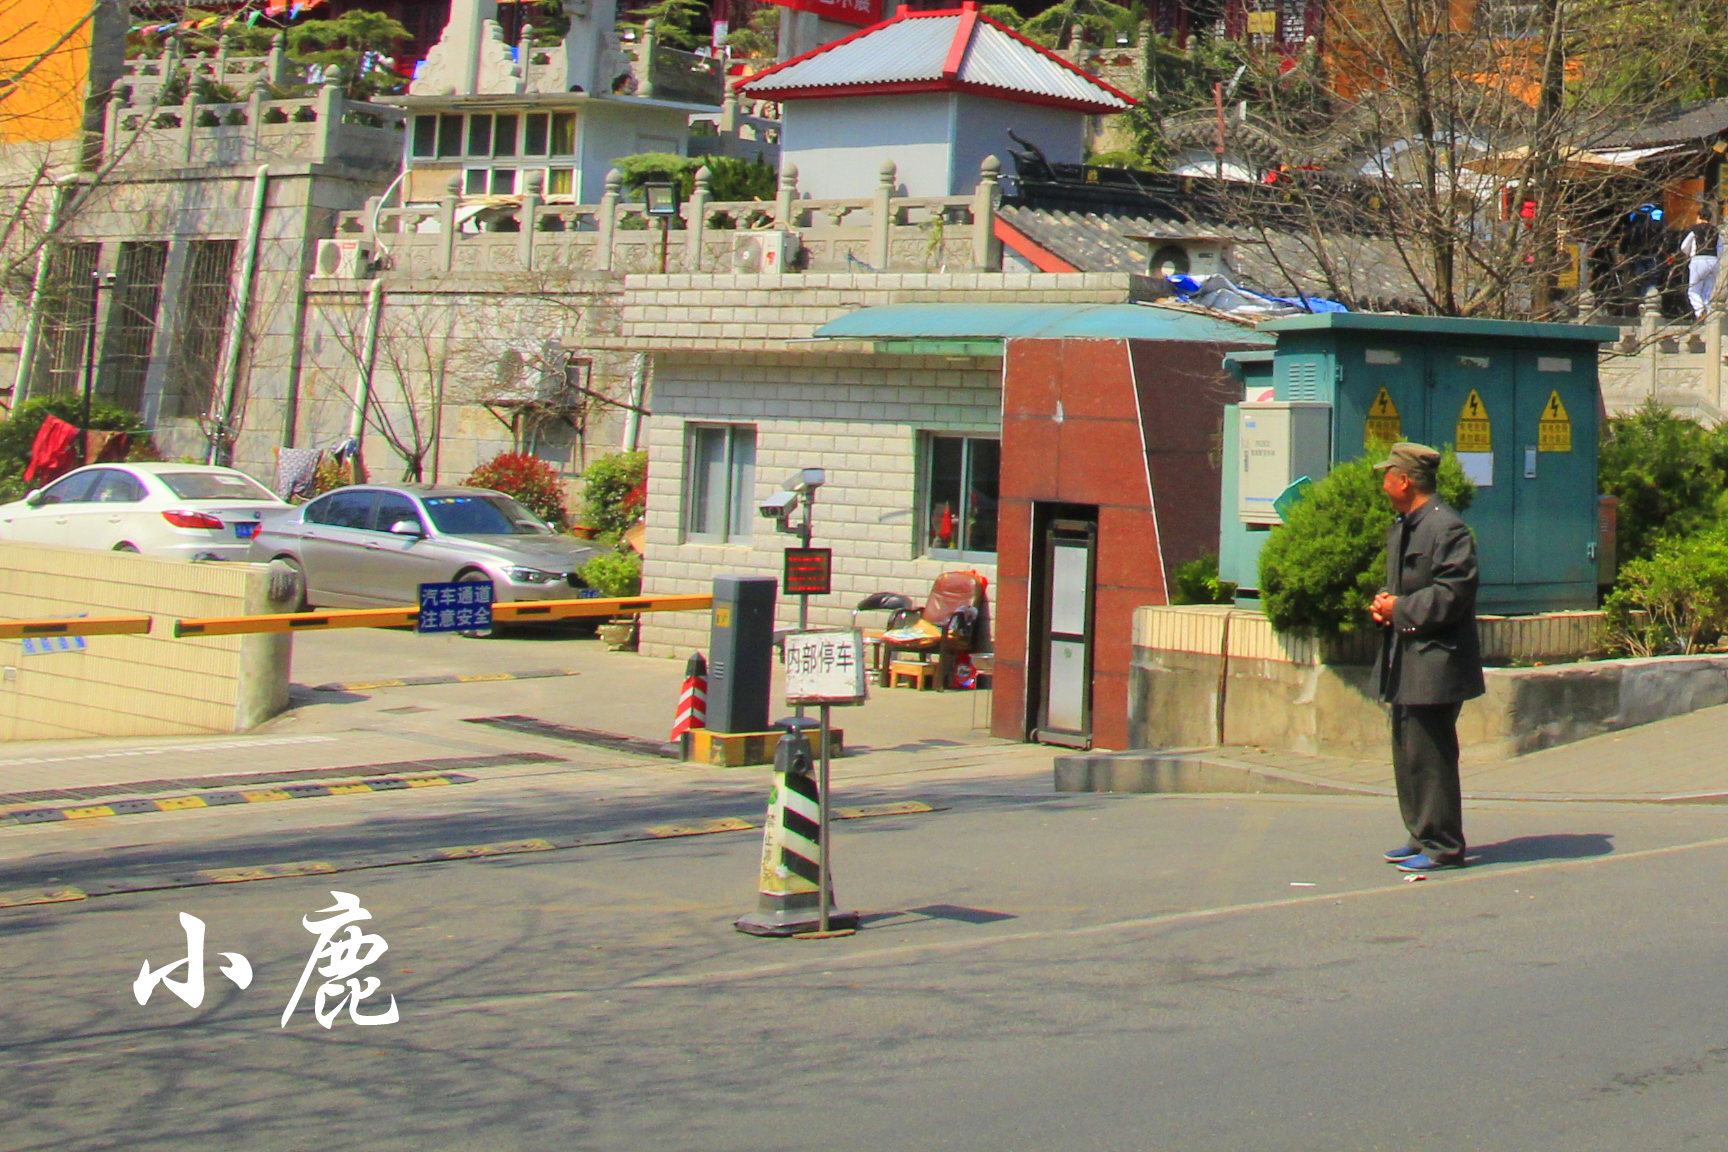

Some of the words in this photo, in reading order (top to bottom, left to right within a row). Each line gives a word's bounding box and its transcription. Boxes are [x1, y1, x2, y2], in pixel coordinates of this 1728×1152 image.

[421, 585, 492, 607] 汽车通道
[420, 606, 490, 629] 注意安全
[786, 641, 854, 674] 内部停车
